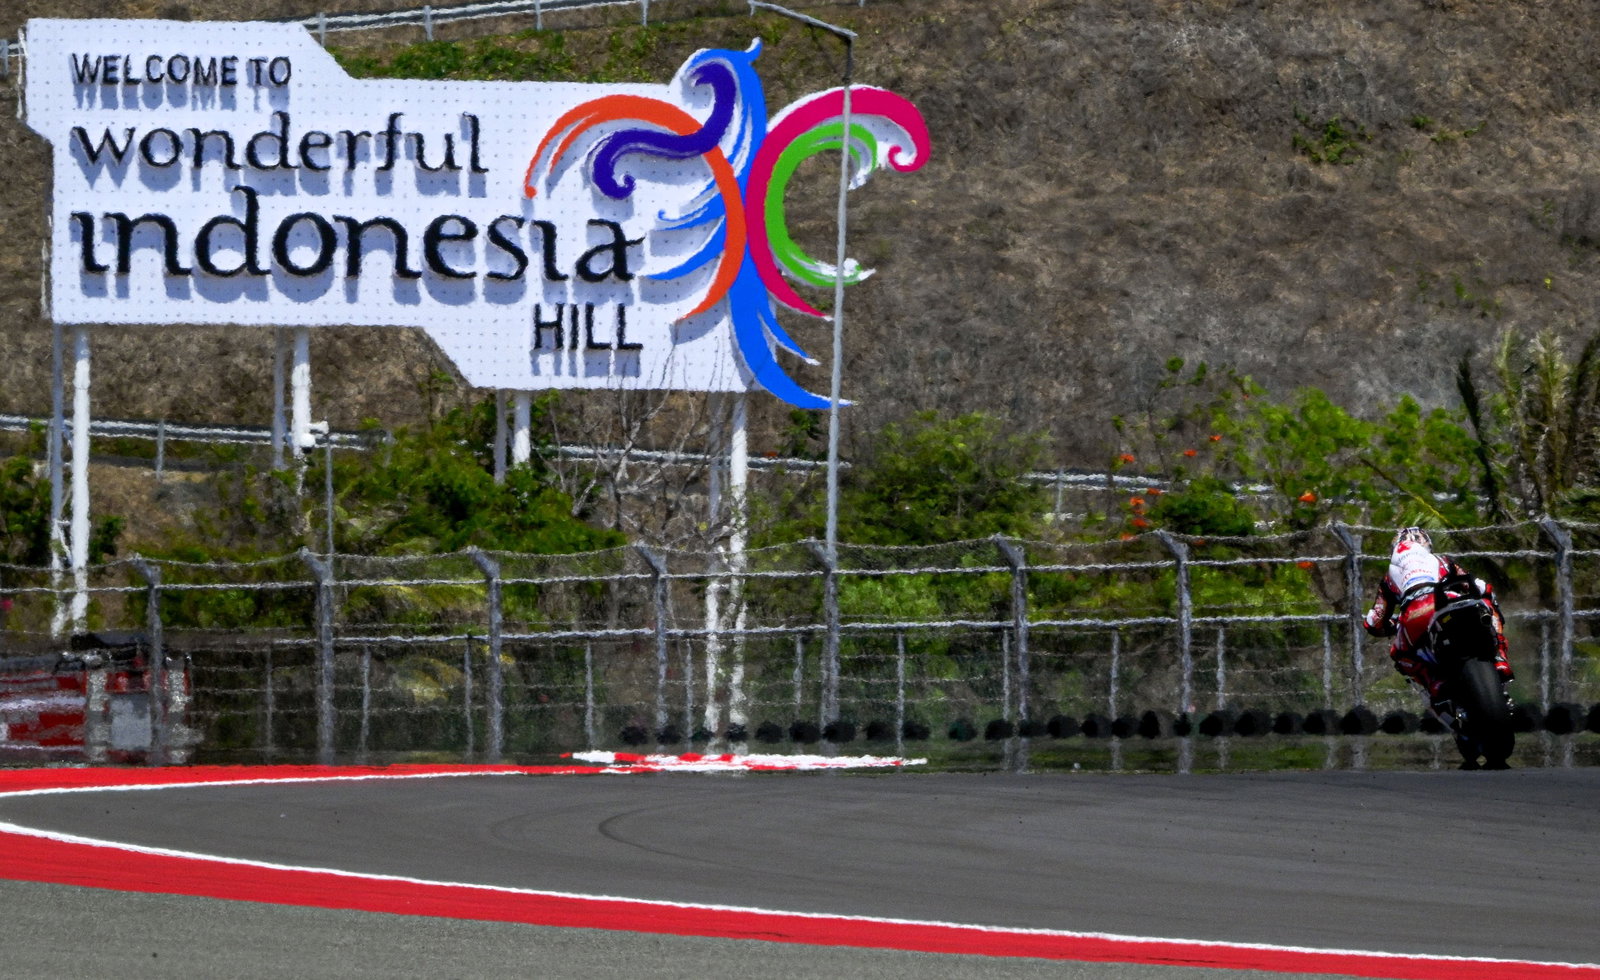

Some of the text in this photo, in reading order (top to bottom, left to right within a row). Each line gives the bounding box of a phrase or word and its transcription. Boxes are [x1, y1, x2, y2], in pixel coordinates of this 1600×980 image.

[72, 53, 292, 86] WELCOME TO
[71, 111, 489, 173] wonderful
[71, 186, 645, 282] indonesia
[532, 303, 643, 351] HILL
